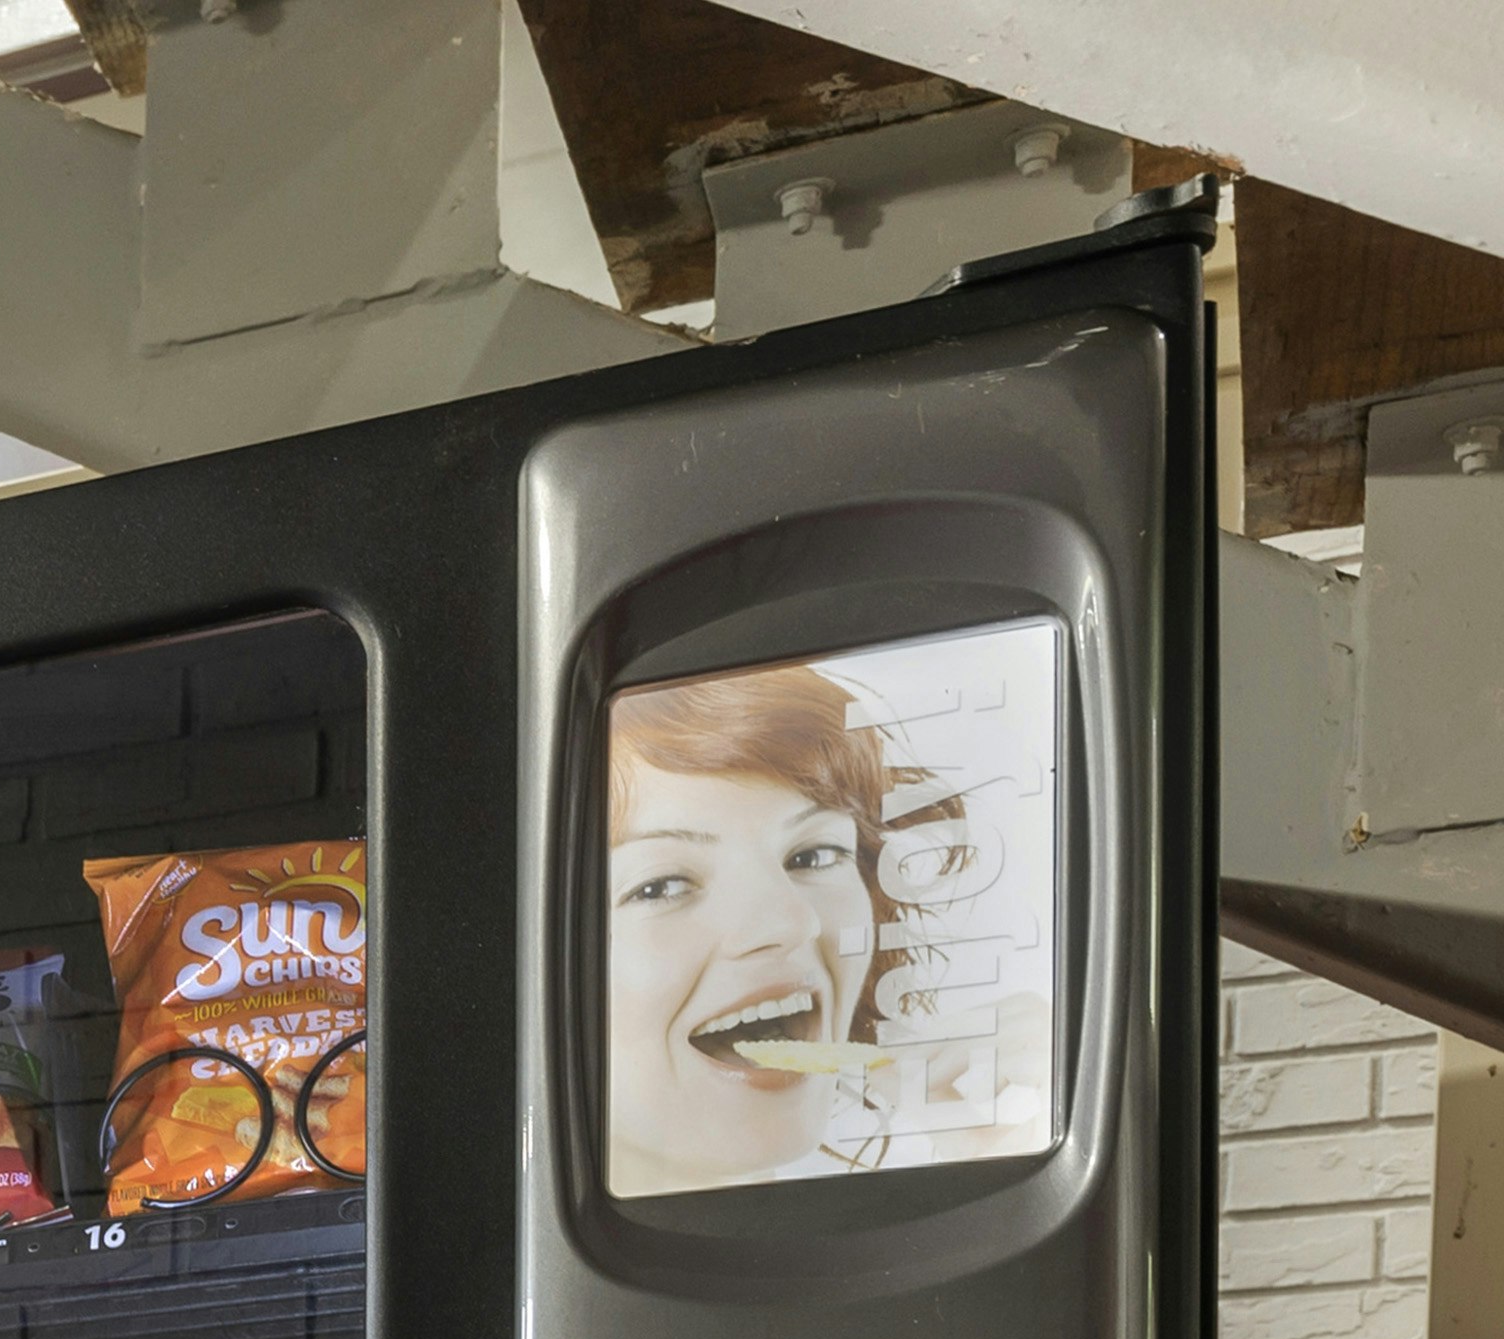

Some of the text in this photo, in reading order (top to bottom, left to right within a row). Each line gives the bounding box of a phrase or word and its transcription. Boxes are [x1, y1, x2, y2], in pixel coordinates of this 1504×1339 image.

[175, 899, 365, 1001] Sun
[243, 956, 362, 987] CHIPS
[85, 1223, 127, 1250] 16
